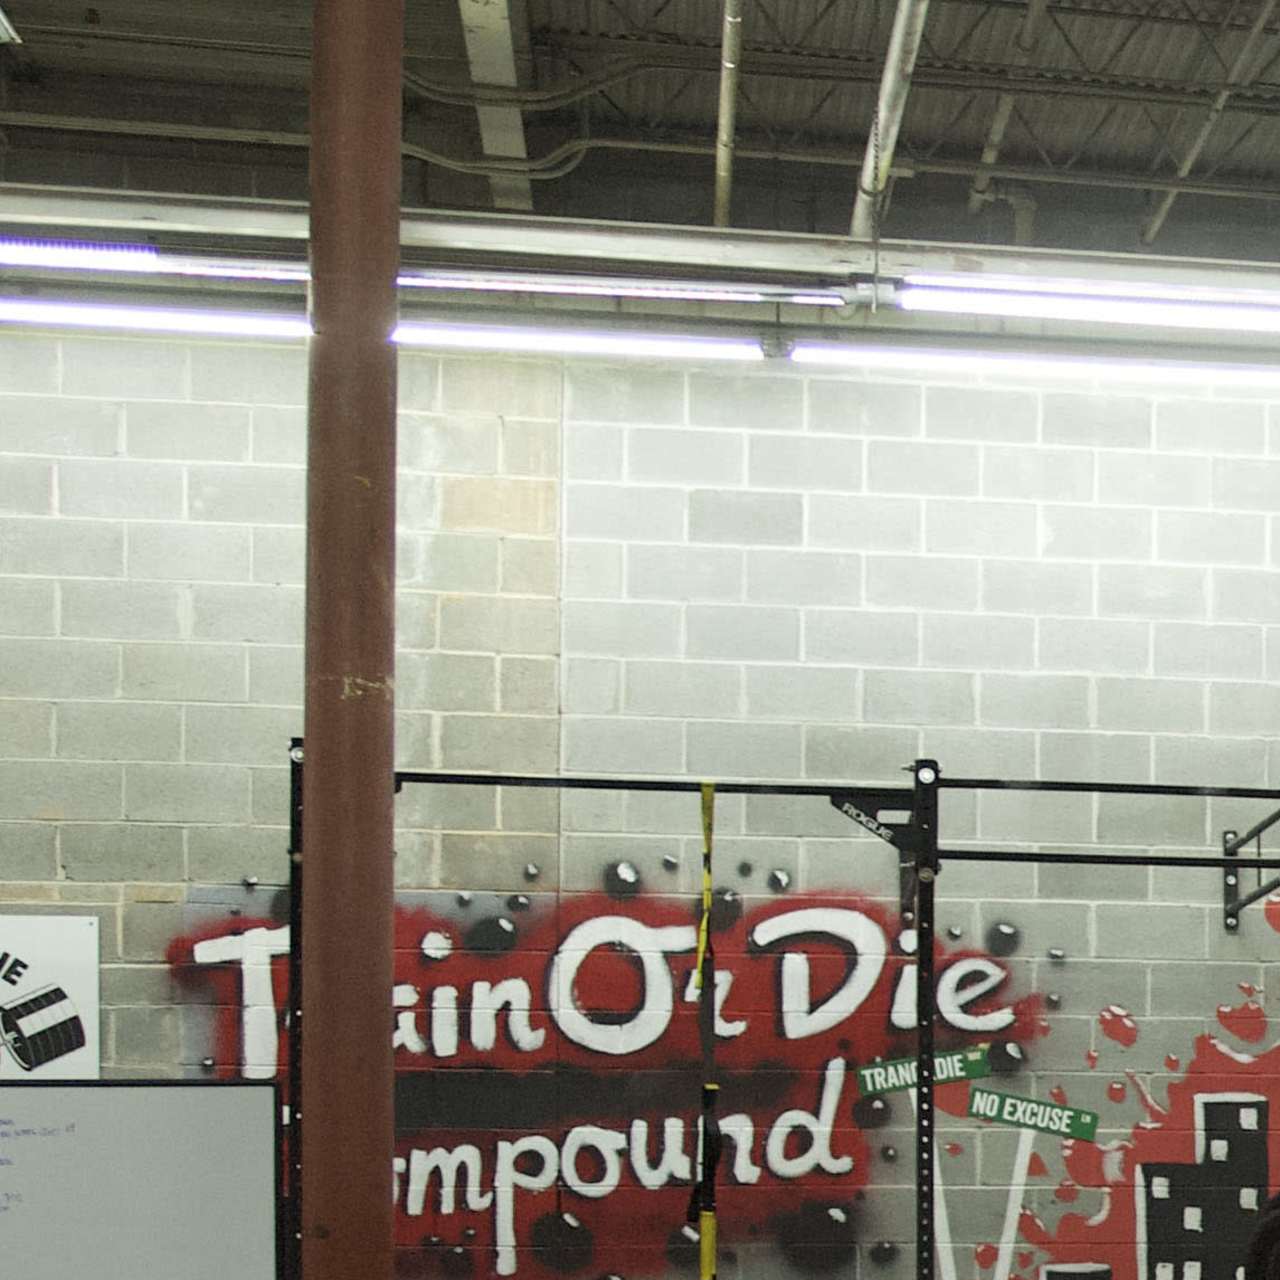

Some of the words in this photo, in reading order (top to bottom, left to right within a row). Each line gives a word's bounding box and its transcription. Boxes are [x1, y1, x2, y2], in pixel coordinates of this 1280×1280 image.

[193, 924, 546, 1080] Tin
[549, 914, 748, 1055] Or
[752, 907, 1015, 1040] Die
[283, 1057, 853, 1275] mpound
[972, 1091, 1000, 1117] NO
[1002, 1097, 1074, 1133] EXCUSE
